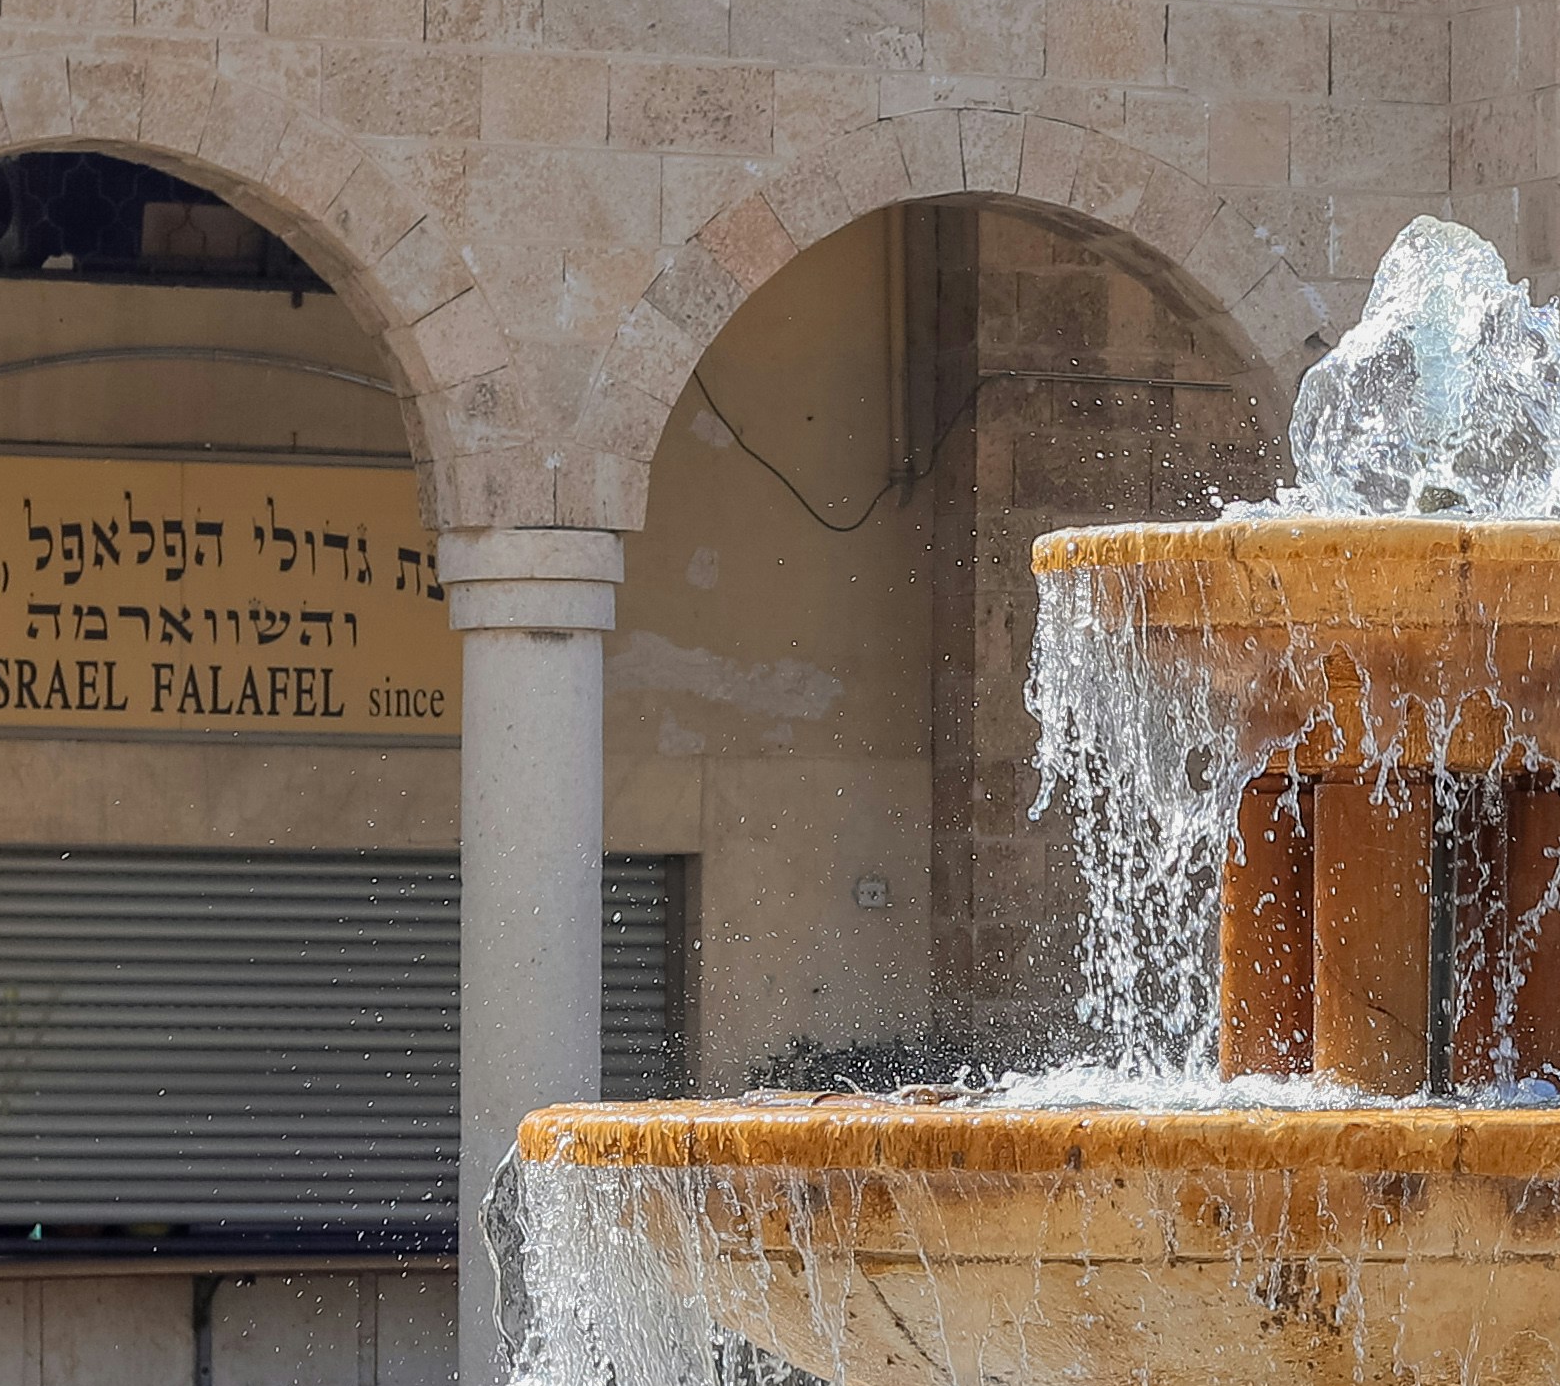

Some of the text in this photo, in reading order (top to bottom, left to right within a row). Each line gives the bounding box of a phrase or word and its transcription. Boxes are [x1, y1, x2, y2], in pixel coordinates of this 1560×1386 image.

[23, 490, 224, 586] הפלאפל
[253, 496, 373, 585] גדולי
[26, 597, 357, 648] והשווארמה
[150, 662, 345, 717] FALAFEL
[368, 675, 445, 719] since
